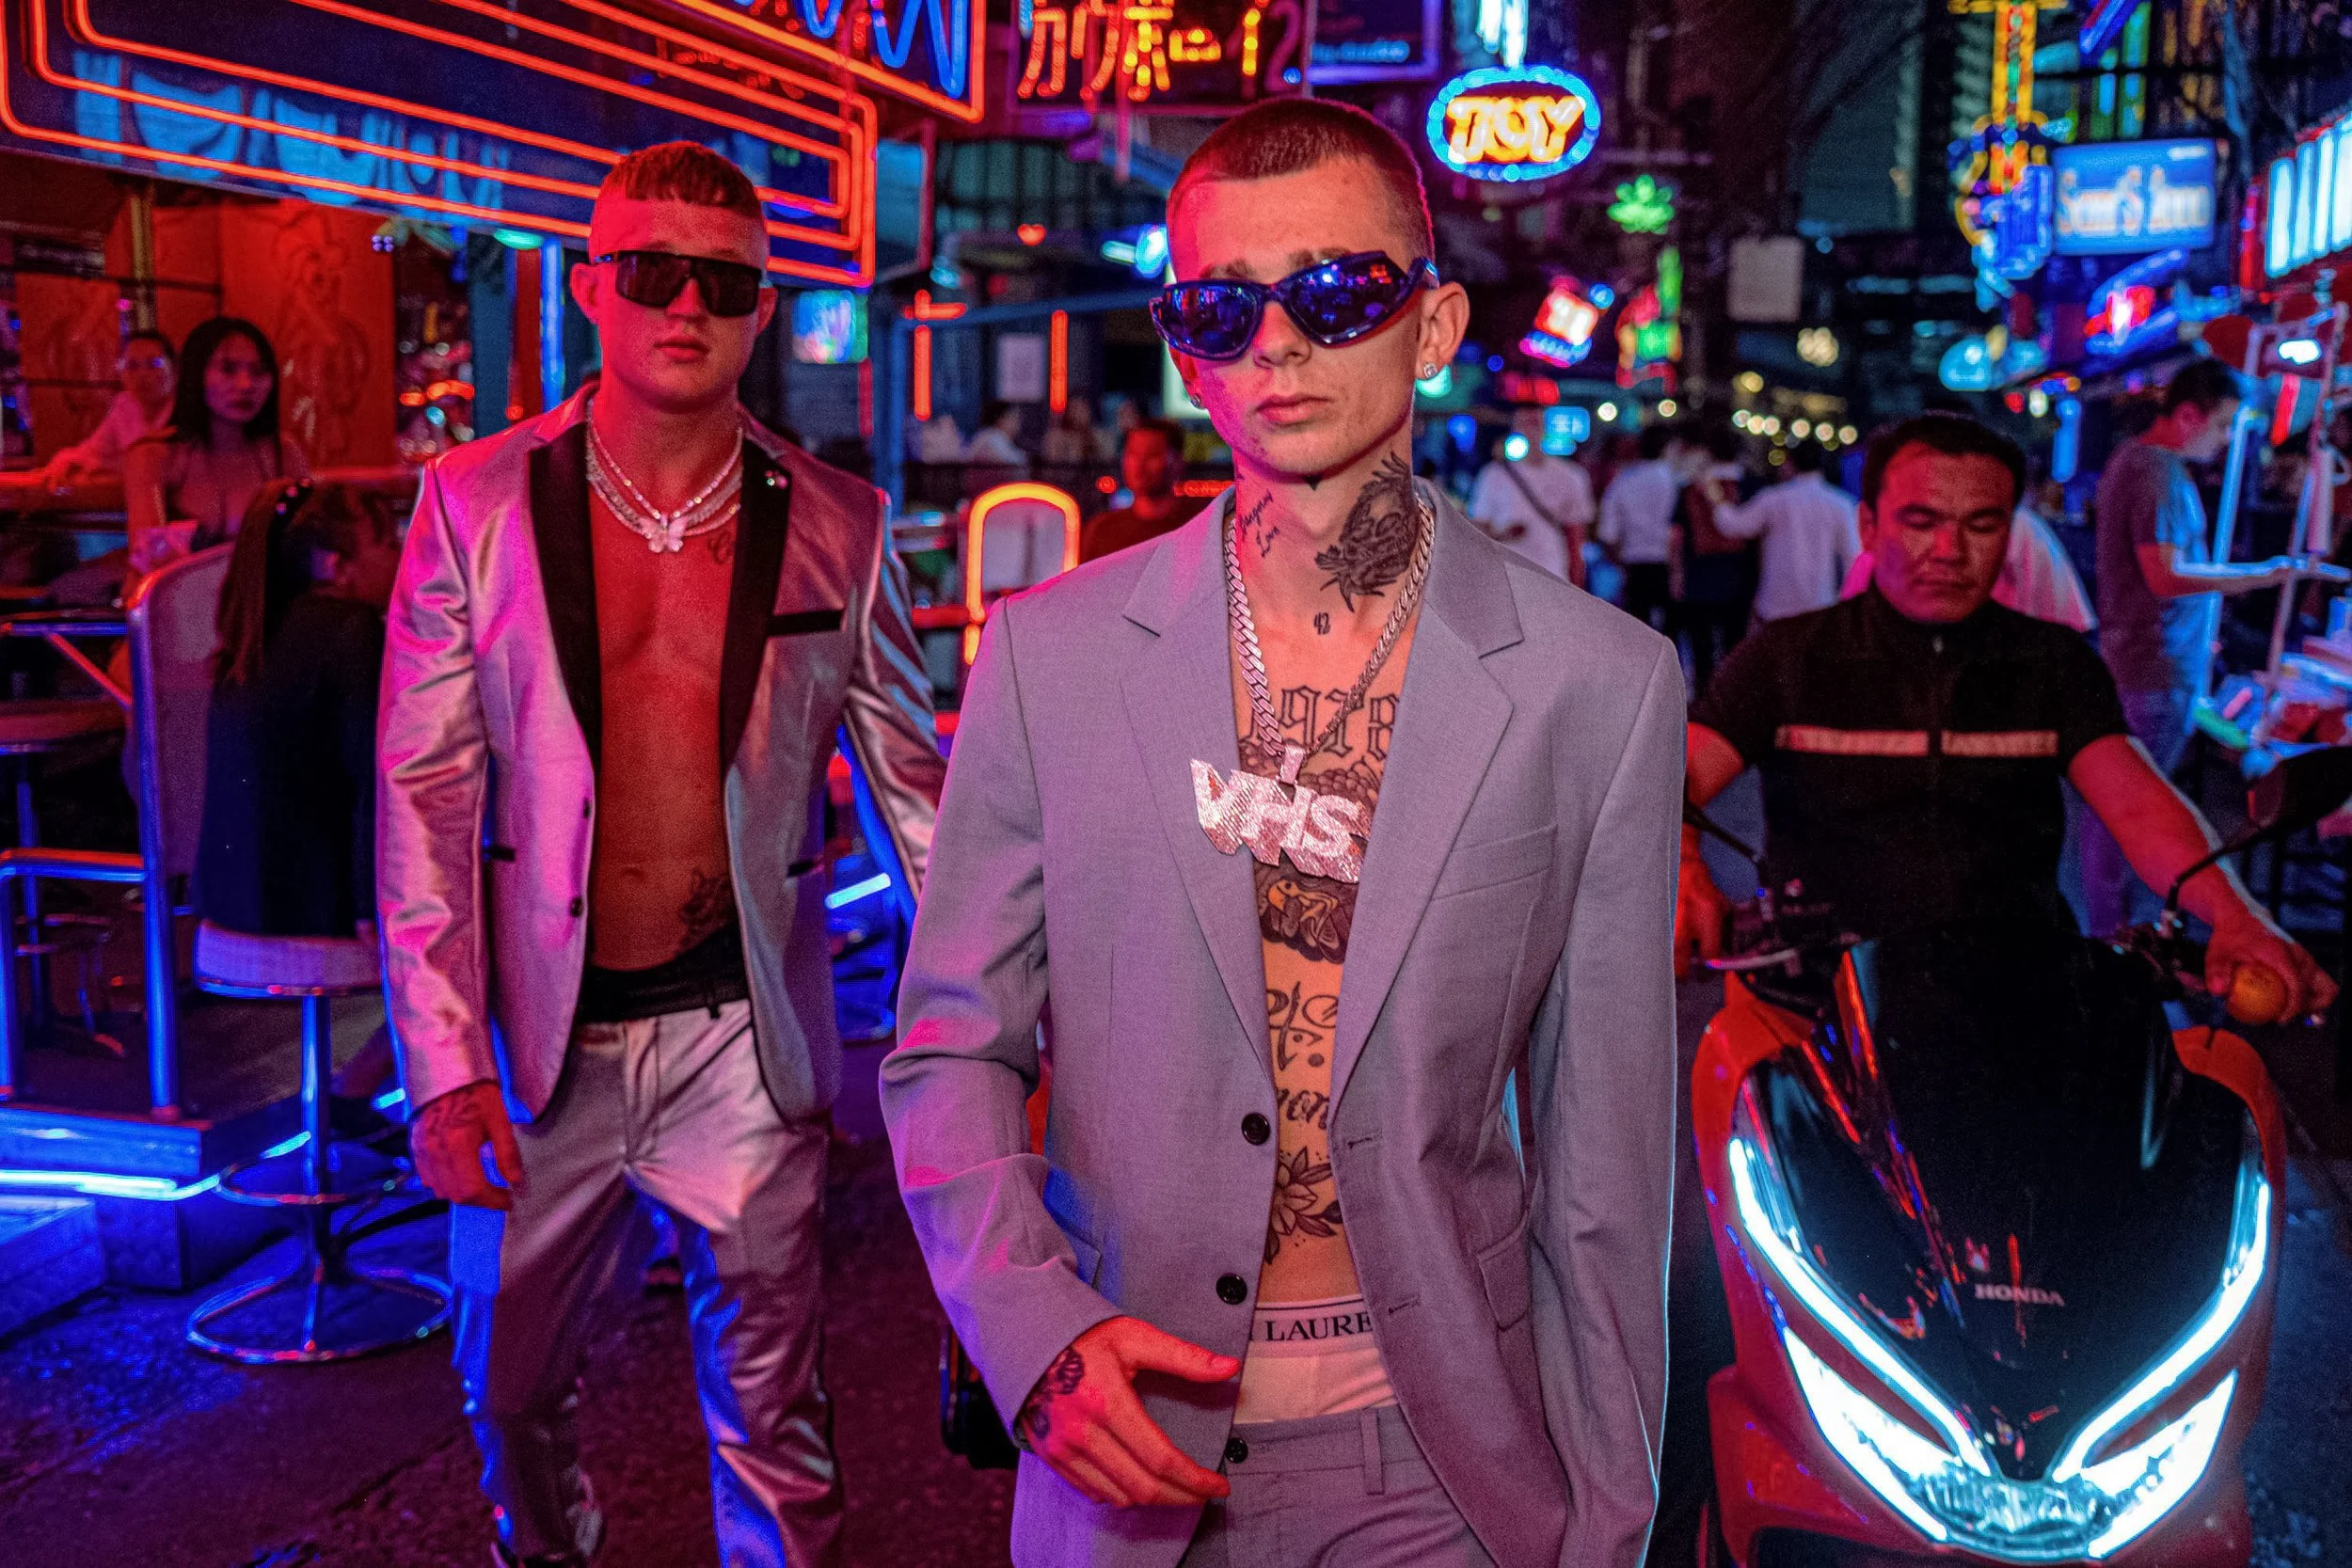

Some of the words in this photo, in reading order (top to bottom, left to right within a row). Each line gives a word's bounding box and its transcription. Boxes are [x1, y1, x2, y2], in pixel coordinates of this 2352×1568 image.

[1447, 96, 1587, 163] TOY
[1190, 758, 1371, 883] VHS
[1975, 1283, 2065, 1307] HONDA
